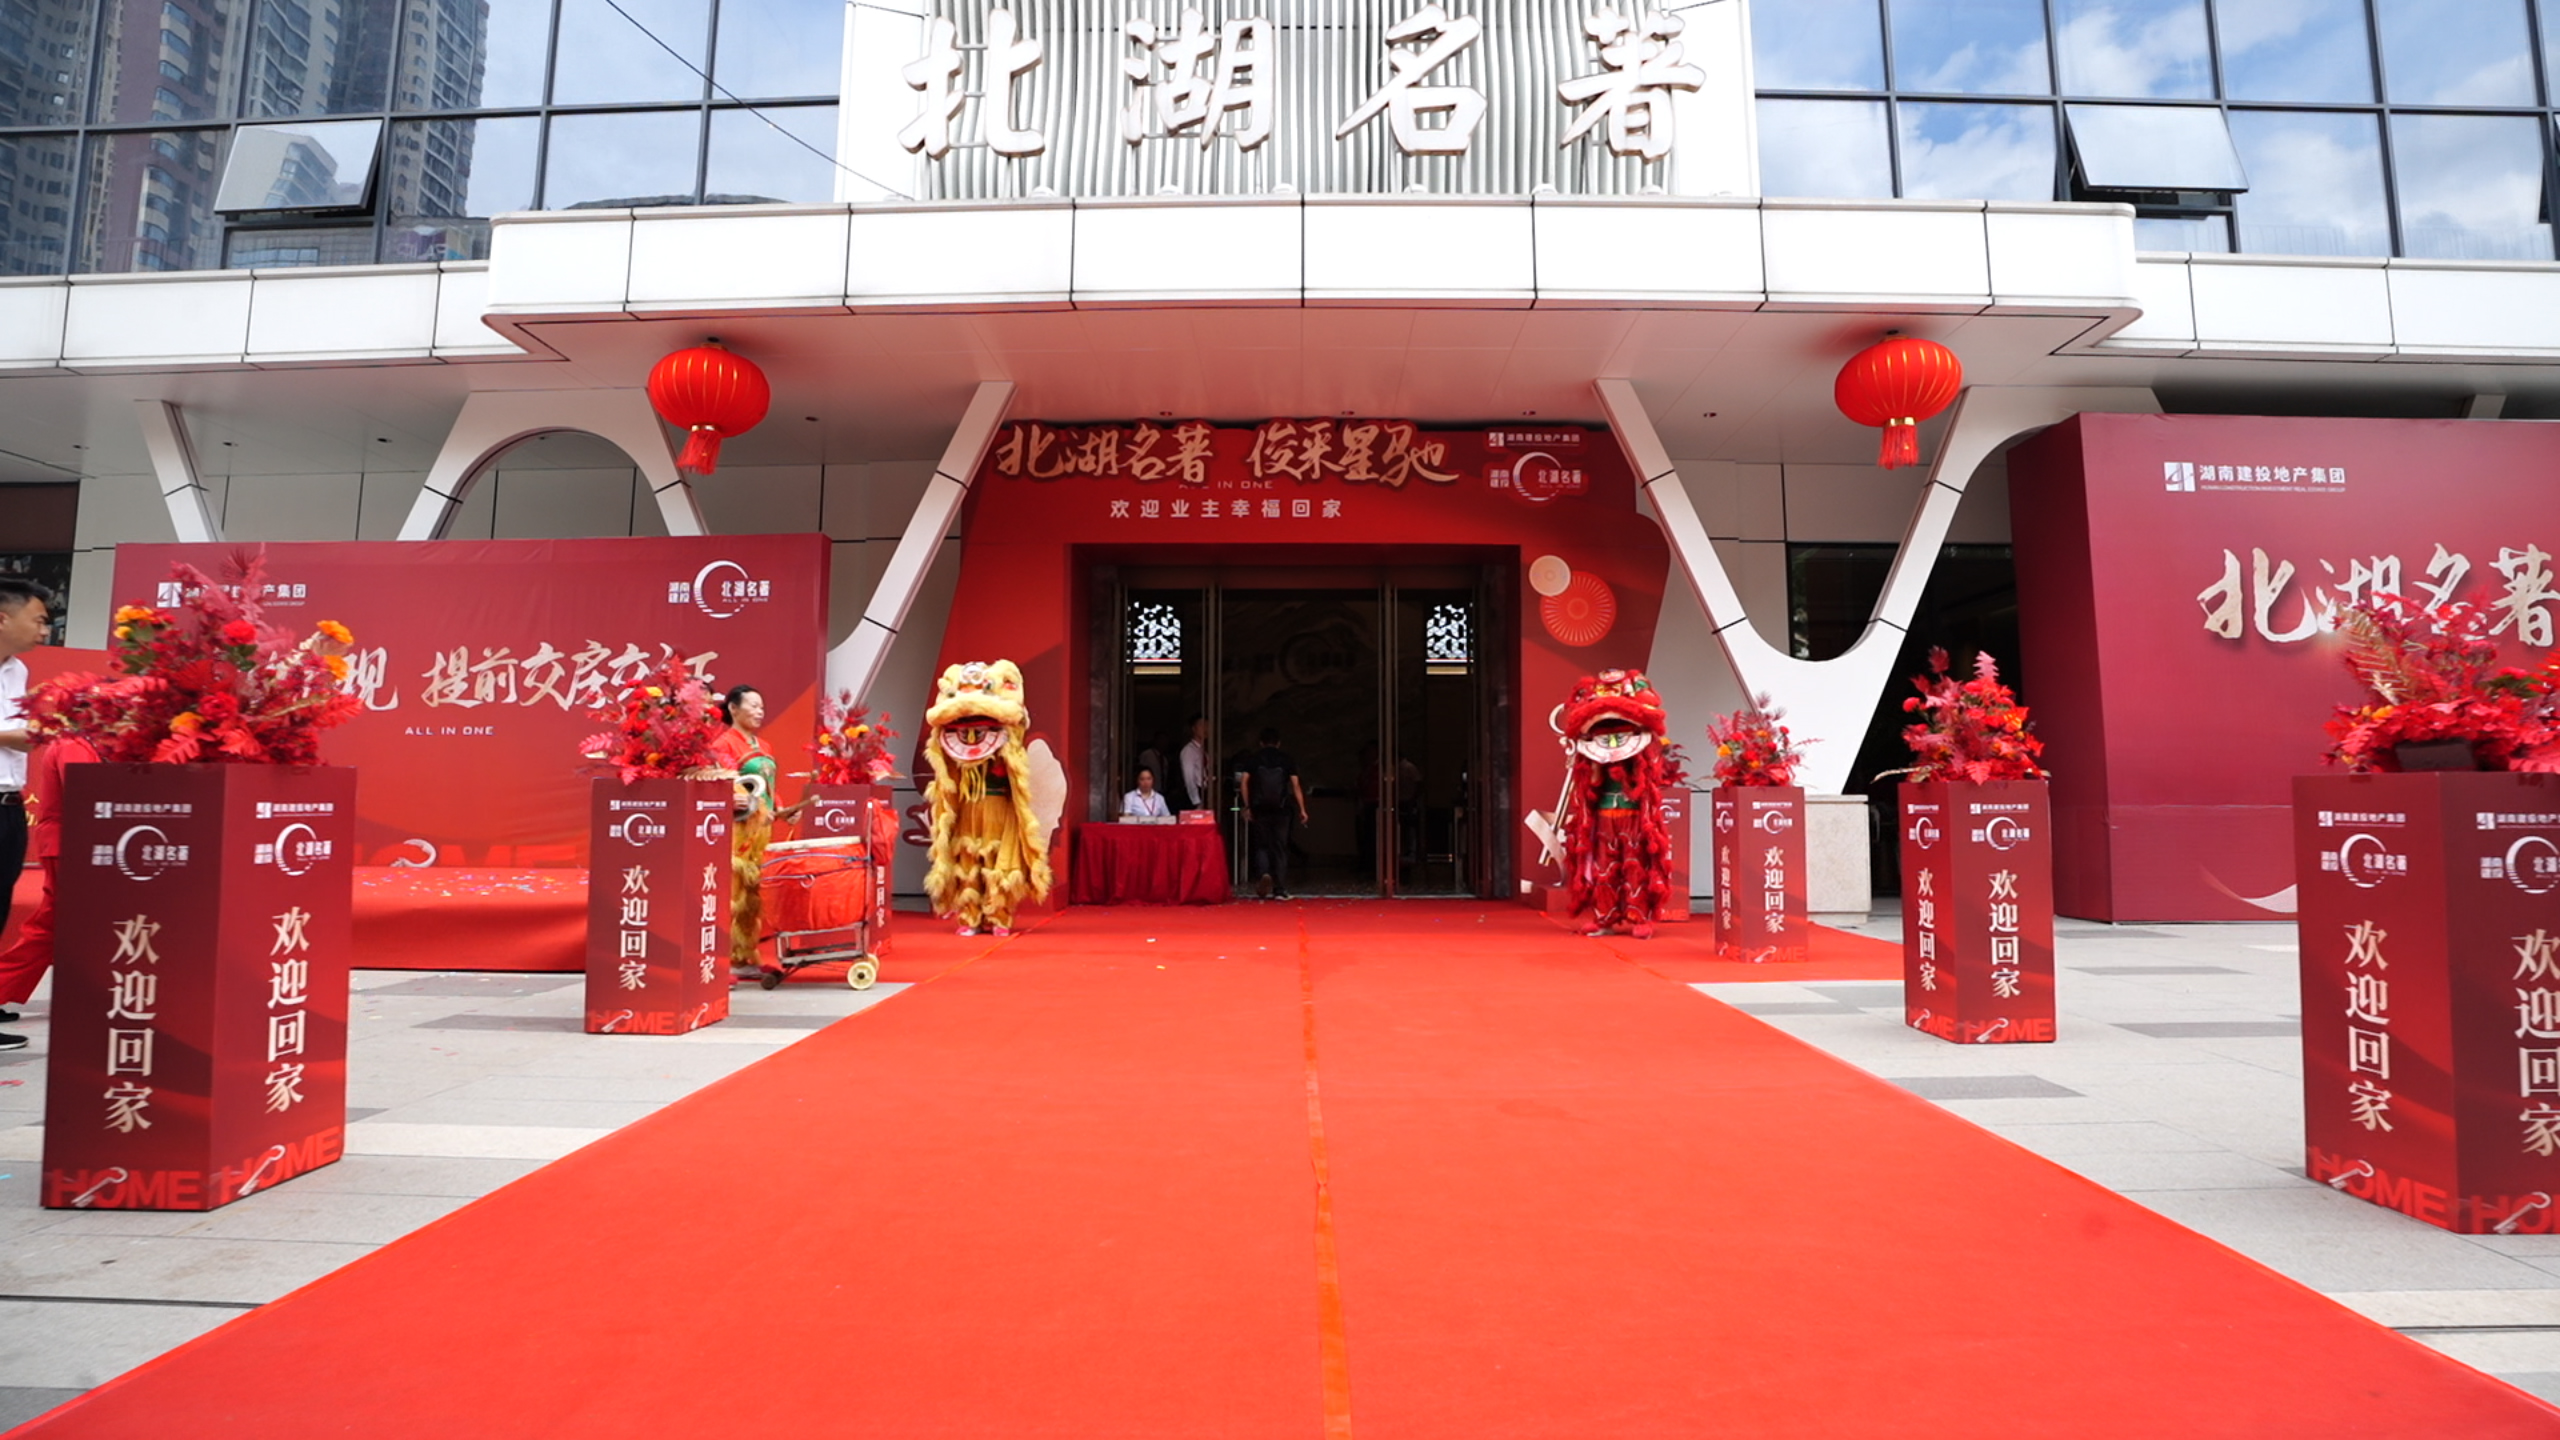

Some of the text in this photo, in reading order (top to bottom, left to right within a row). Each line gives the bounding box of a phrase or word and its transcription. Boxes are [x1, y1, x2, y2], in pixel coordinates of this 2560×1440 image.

[898, 4, 1706, 163] 北湖名著
[997, 423, 1460, 486] 北湖名著 俊采星驰
[1218, 481, 1233, 489] IN
[1241, 481, 1273, 489] ONE
[2199, 465, 2346, 484] 湖南建投地产集团
[1110, 500, 1342, 518] 欢迎业主幸福回家
[405, 726, 494, 735] ALL IN ONE
[1764, 846, 1785, 933] 欢迎回家
[2533, 856, 2560, 873] 北湖
[618, 864, 650, 991] 欢迎回家
[700, 862, 718, 984] 欢迎回家
[1917, 867, 1937, 991] 欢迎回家
[1988, 869, 2021, 998] 欢迎回家
[103, 914, 161, 1133] 欢迎回家
[264, 906, 311, 1114] 欢迎回家
[2343, 919, 2394, 1133] 欢迎回家
[2511, 929, 2560, 1157] 欢迎回家
[52, 1168, 200, 1208] HOME
[221, 1126, 341, 1204] HOME
[2310, 1146, 2450, 1229] HOME
